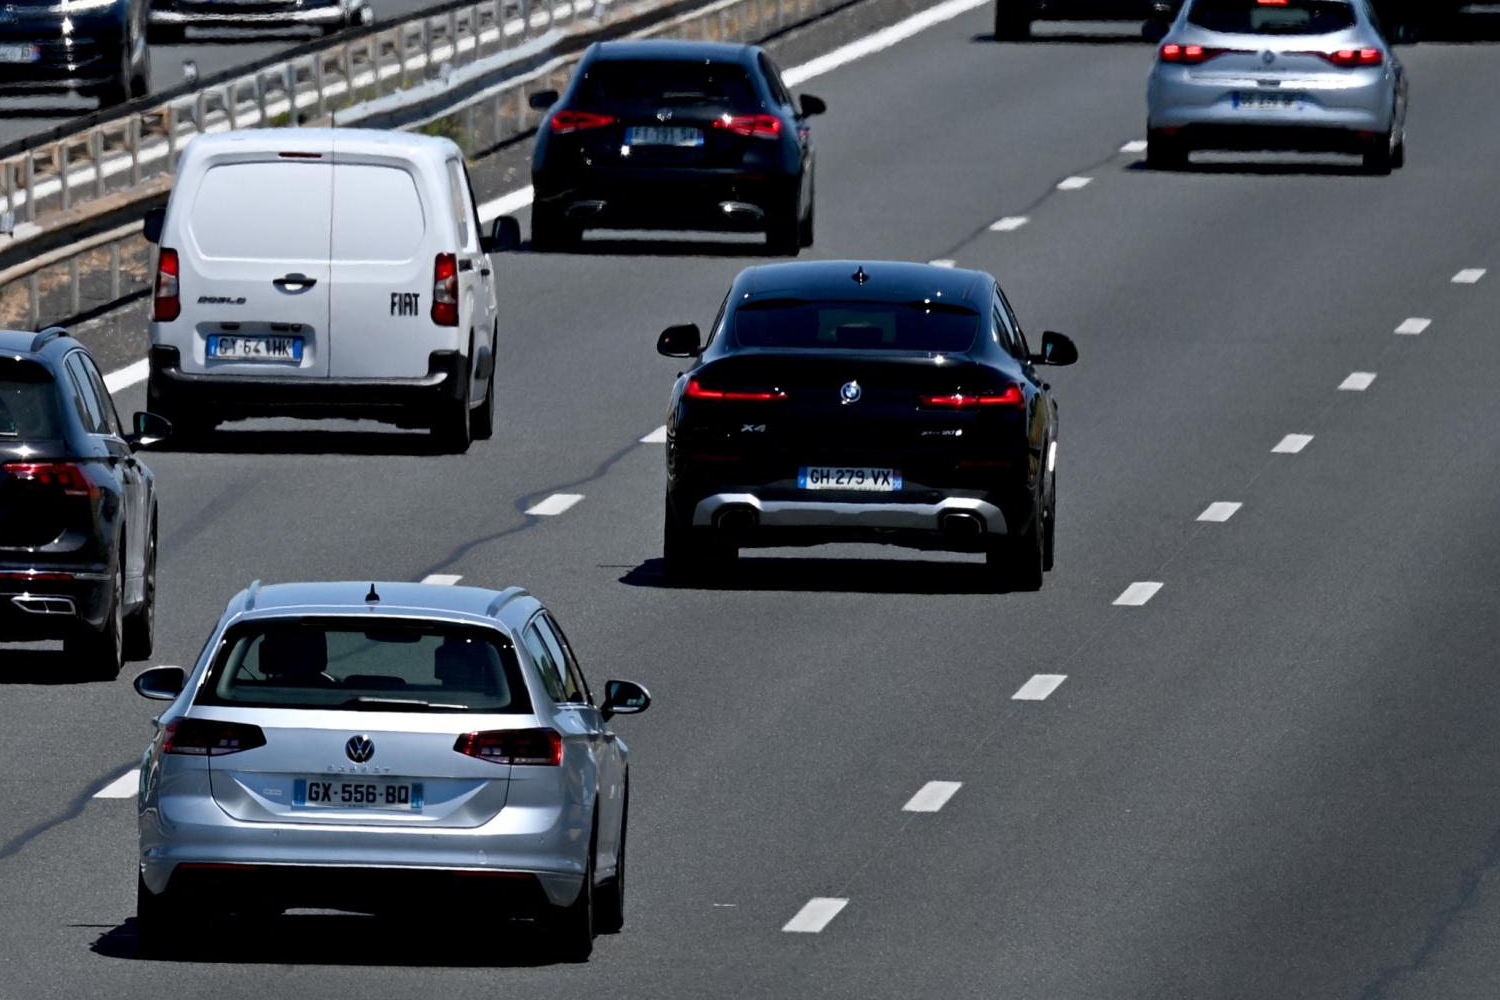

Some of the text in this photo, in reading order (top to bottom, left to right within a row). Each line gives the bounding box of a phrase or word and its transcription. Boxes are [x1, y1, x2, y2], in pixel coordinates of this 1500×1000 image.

[390, 292, 420, 316] FIAT
[810, 469, 890, 486] GH-279-VX
[308, 782, 409, 804] GX-556-BQ
